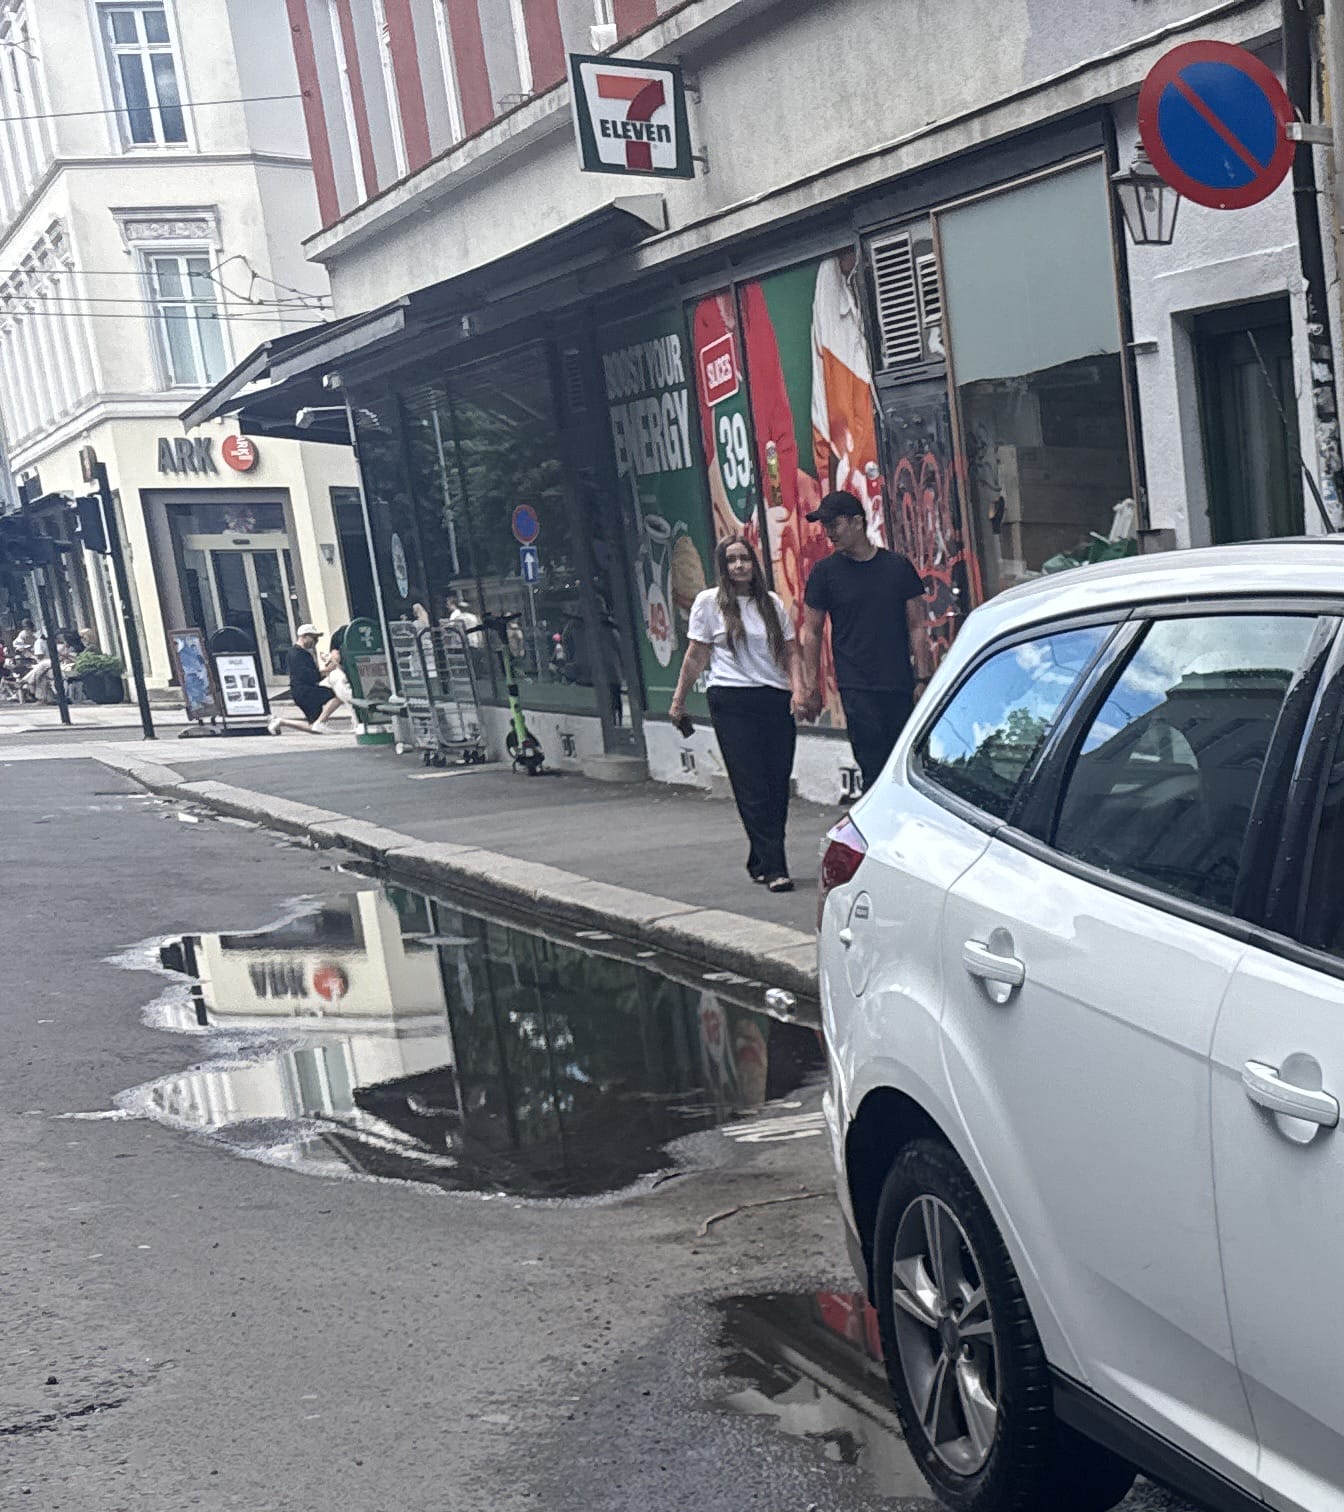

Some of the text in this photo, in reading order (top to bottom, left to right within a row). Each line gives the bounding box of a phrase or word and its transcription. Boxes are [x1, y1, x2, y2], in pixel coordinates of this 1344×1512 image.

[596, 73, 666, 170] 7
[643, 334, 685, 389] YOUR
[157, 437, 218, 474] ARK
[610, 388, 692, 478] ENERGY
